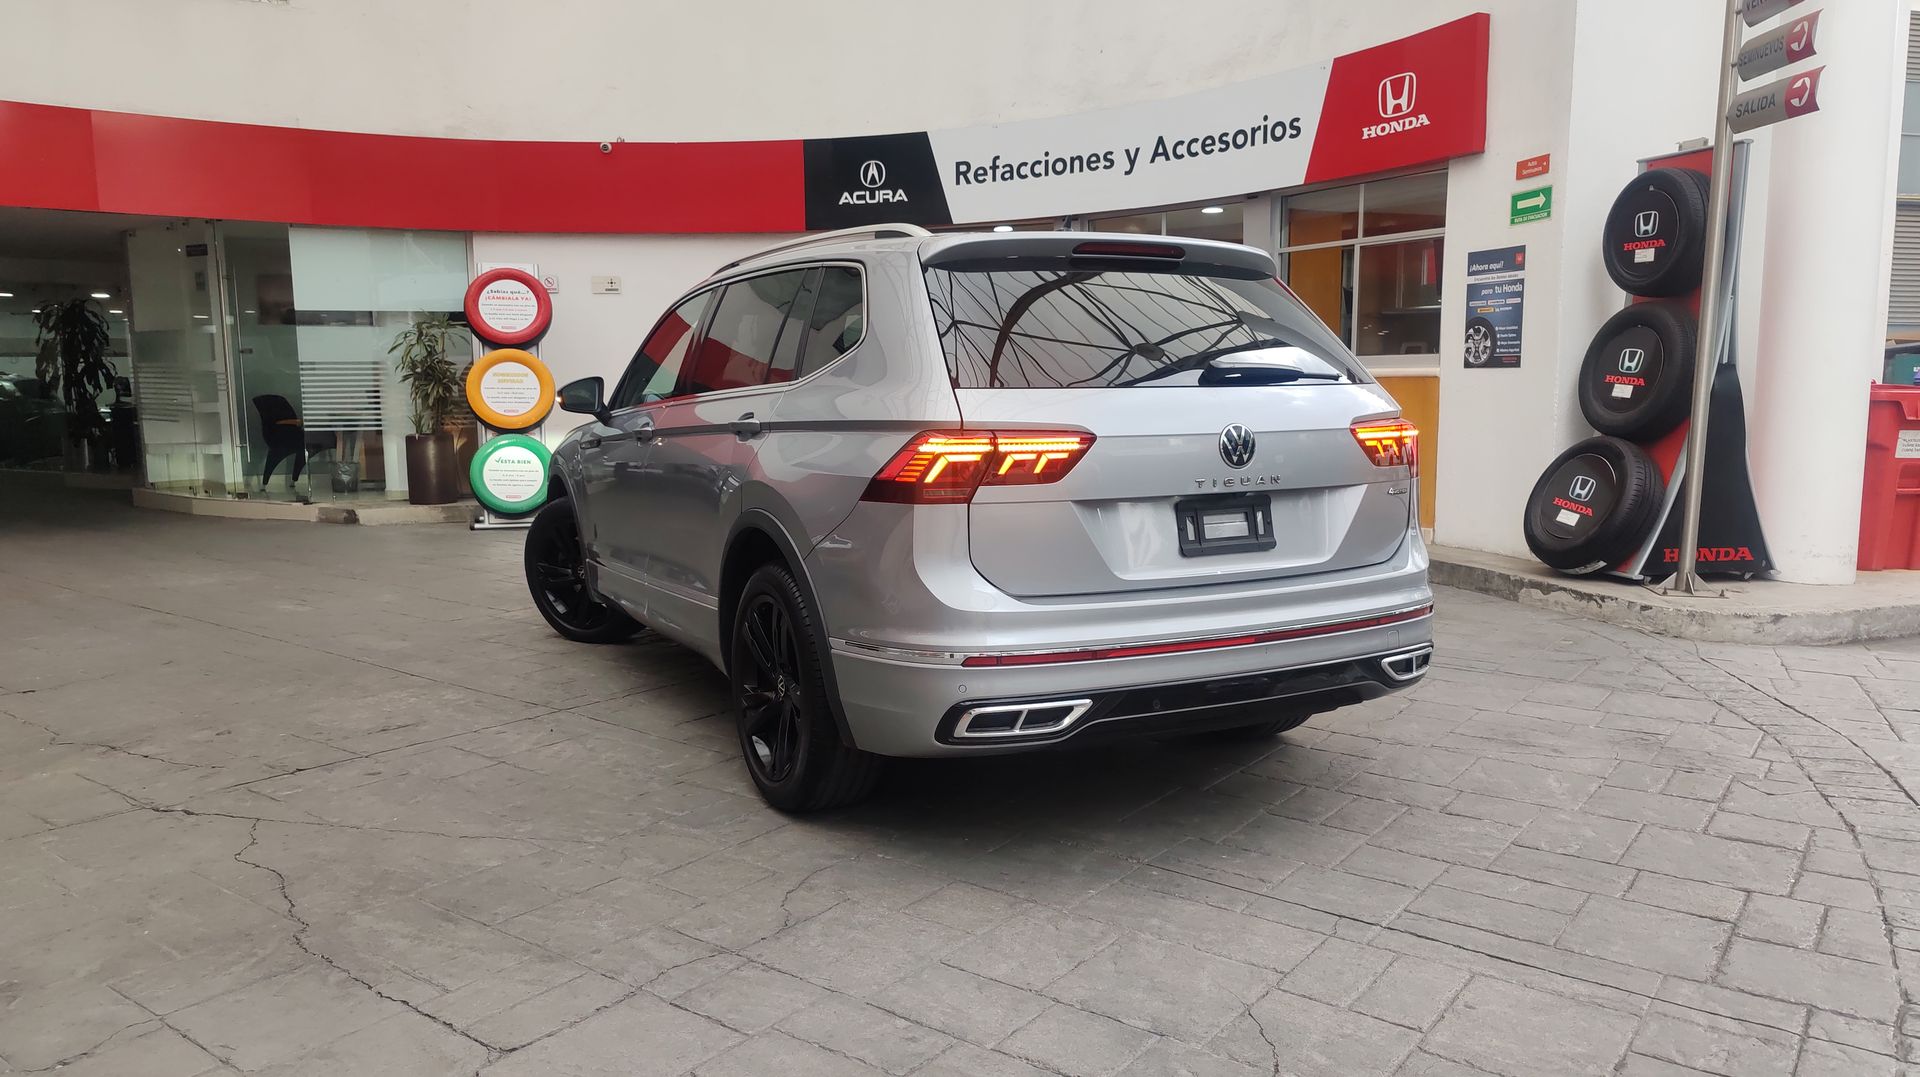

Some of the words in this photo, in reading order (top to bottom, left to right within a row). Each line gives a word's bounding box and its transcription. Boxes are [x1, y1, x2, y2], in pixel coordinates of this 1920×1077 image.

[1739, 37, 1785, 67] SEMINUEVOS
[1735, 93, 1776, 118] SALIDA
[1361, 113, 1430, 140] HONDA
[955, 151, 1115, 185] Refacciones
[1124, 147, 1140, 176] y
[1149, 115, 1302, 164] Accesorios
[838, 188, 909, 205] ACURA
[1624, 239, 1665, 251] HONDA
[1494, 285, 1502, 293] tu
[1502, 282, 1523, 293] Honda
[1605, 375, 1645, 386] HONDA
[1195, 474, 1281, 488] TIGUAN
[1553, 497, 1593, 517] HONDA
[1663, 546, 1755, 562] HNDA
